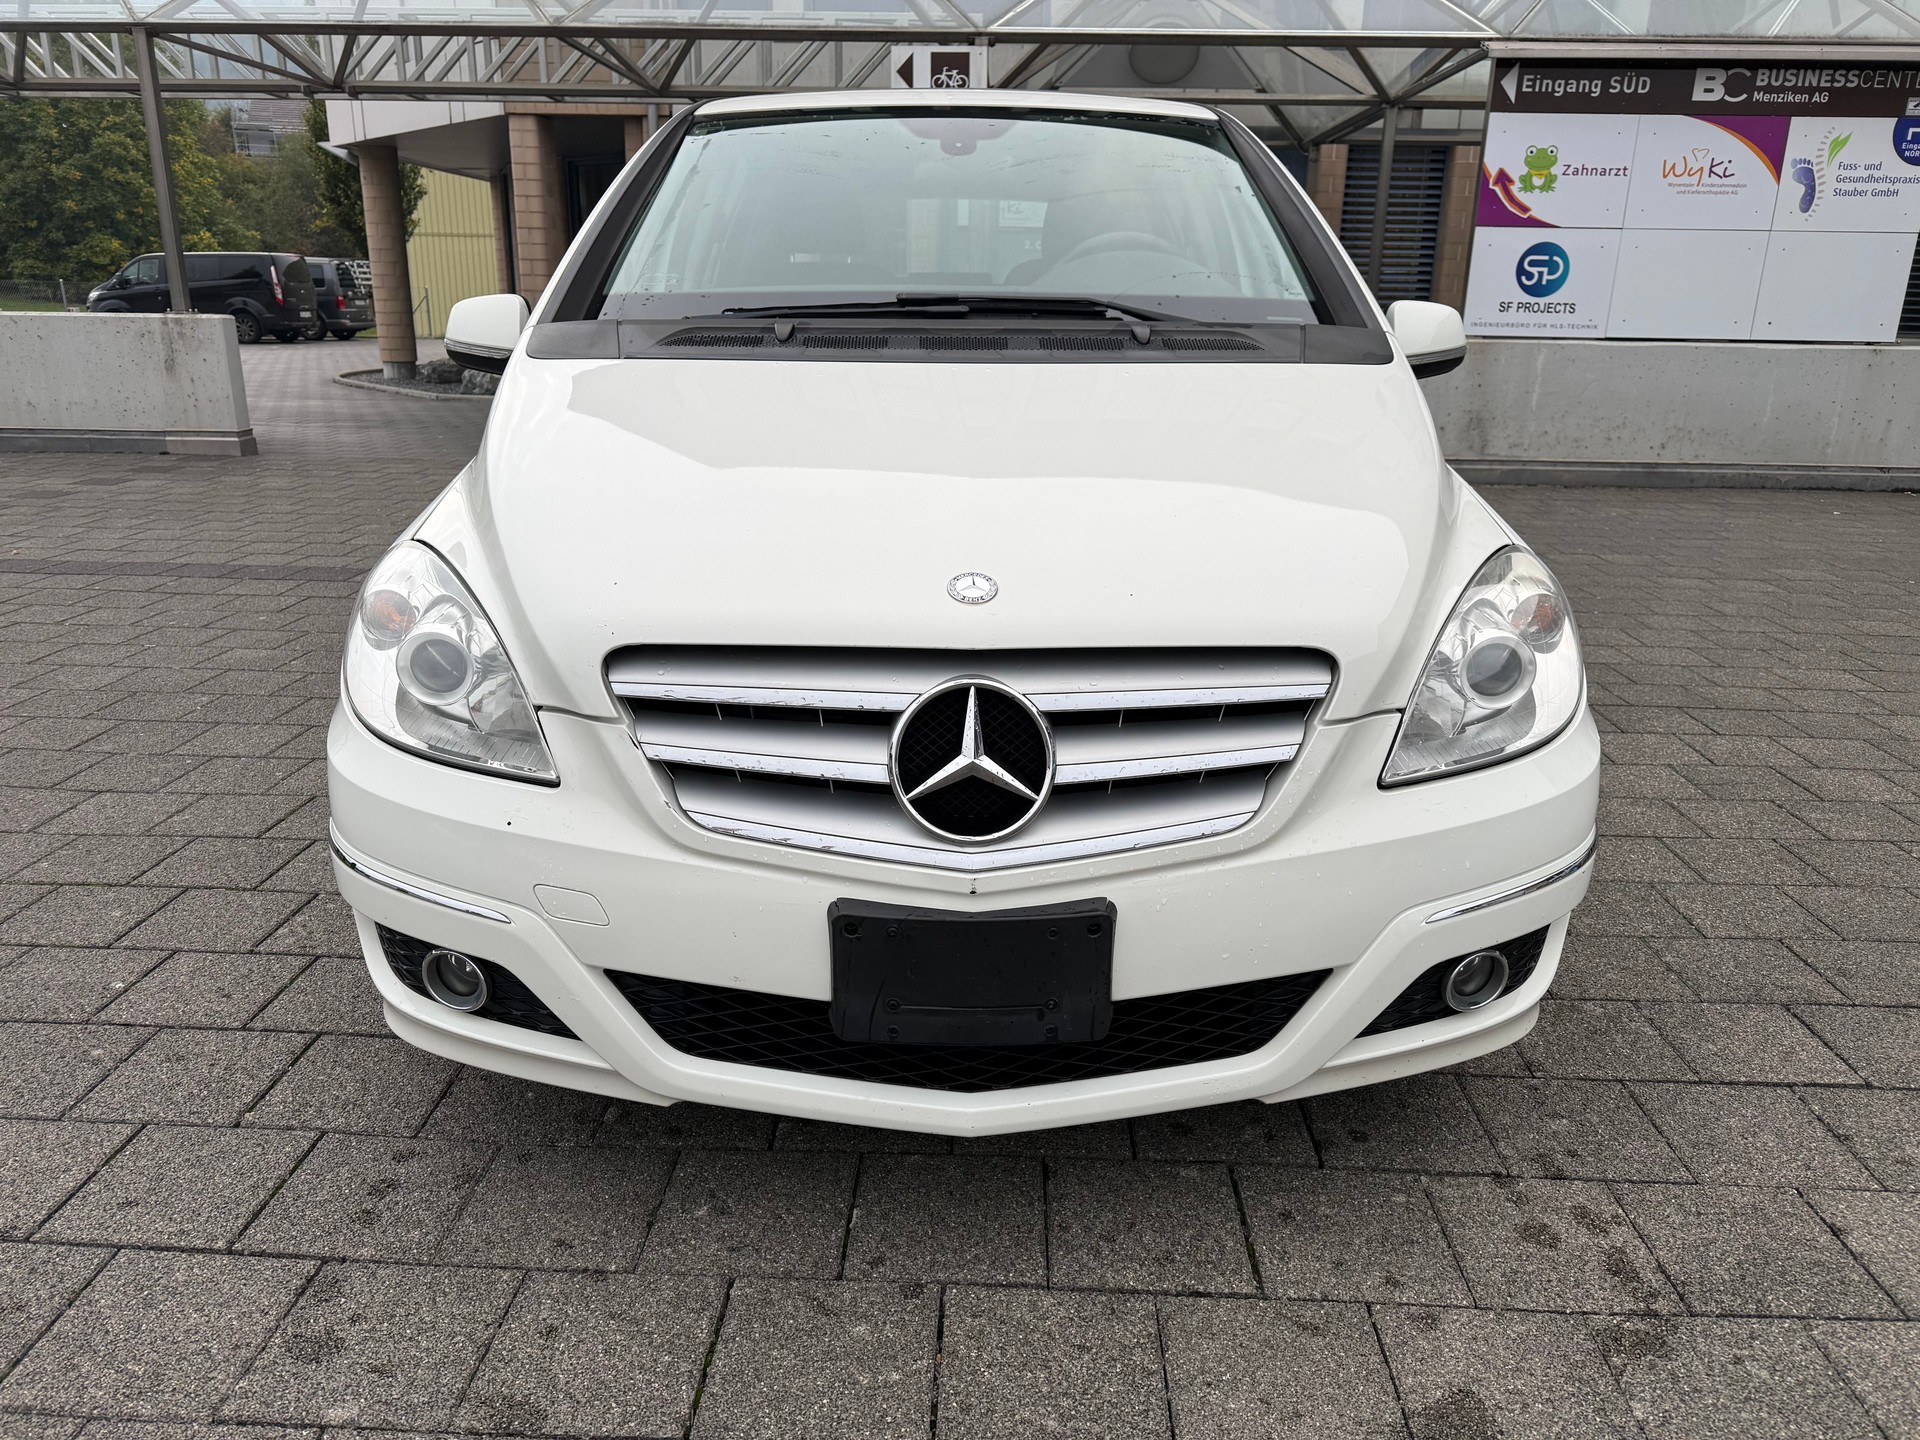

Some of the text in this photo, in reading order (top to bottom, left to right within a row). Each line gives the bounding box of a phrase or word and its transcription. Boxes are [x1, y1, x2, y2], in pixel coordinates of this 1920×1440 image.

[1522, 72, 1651, 97] Eingang SÜD
[1692, 67, 1752, 102] BC
[1753, 91, 1829, 103] Menziken AG
[1561, 163, 1629, 177] Zahnarzt
[1838, 161, 1883, 171] Fuss- und
[1835, 173, 1920, 186] Gesundheitspraxis
[1832, 187, 1900, 198] Stauber GmbH
[1498, 301, 1577, 314] SF PROJECTS
